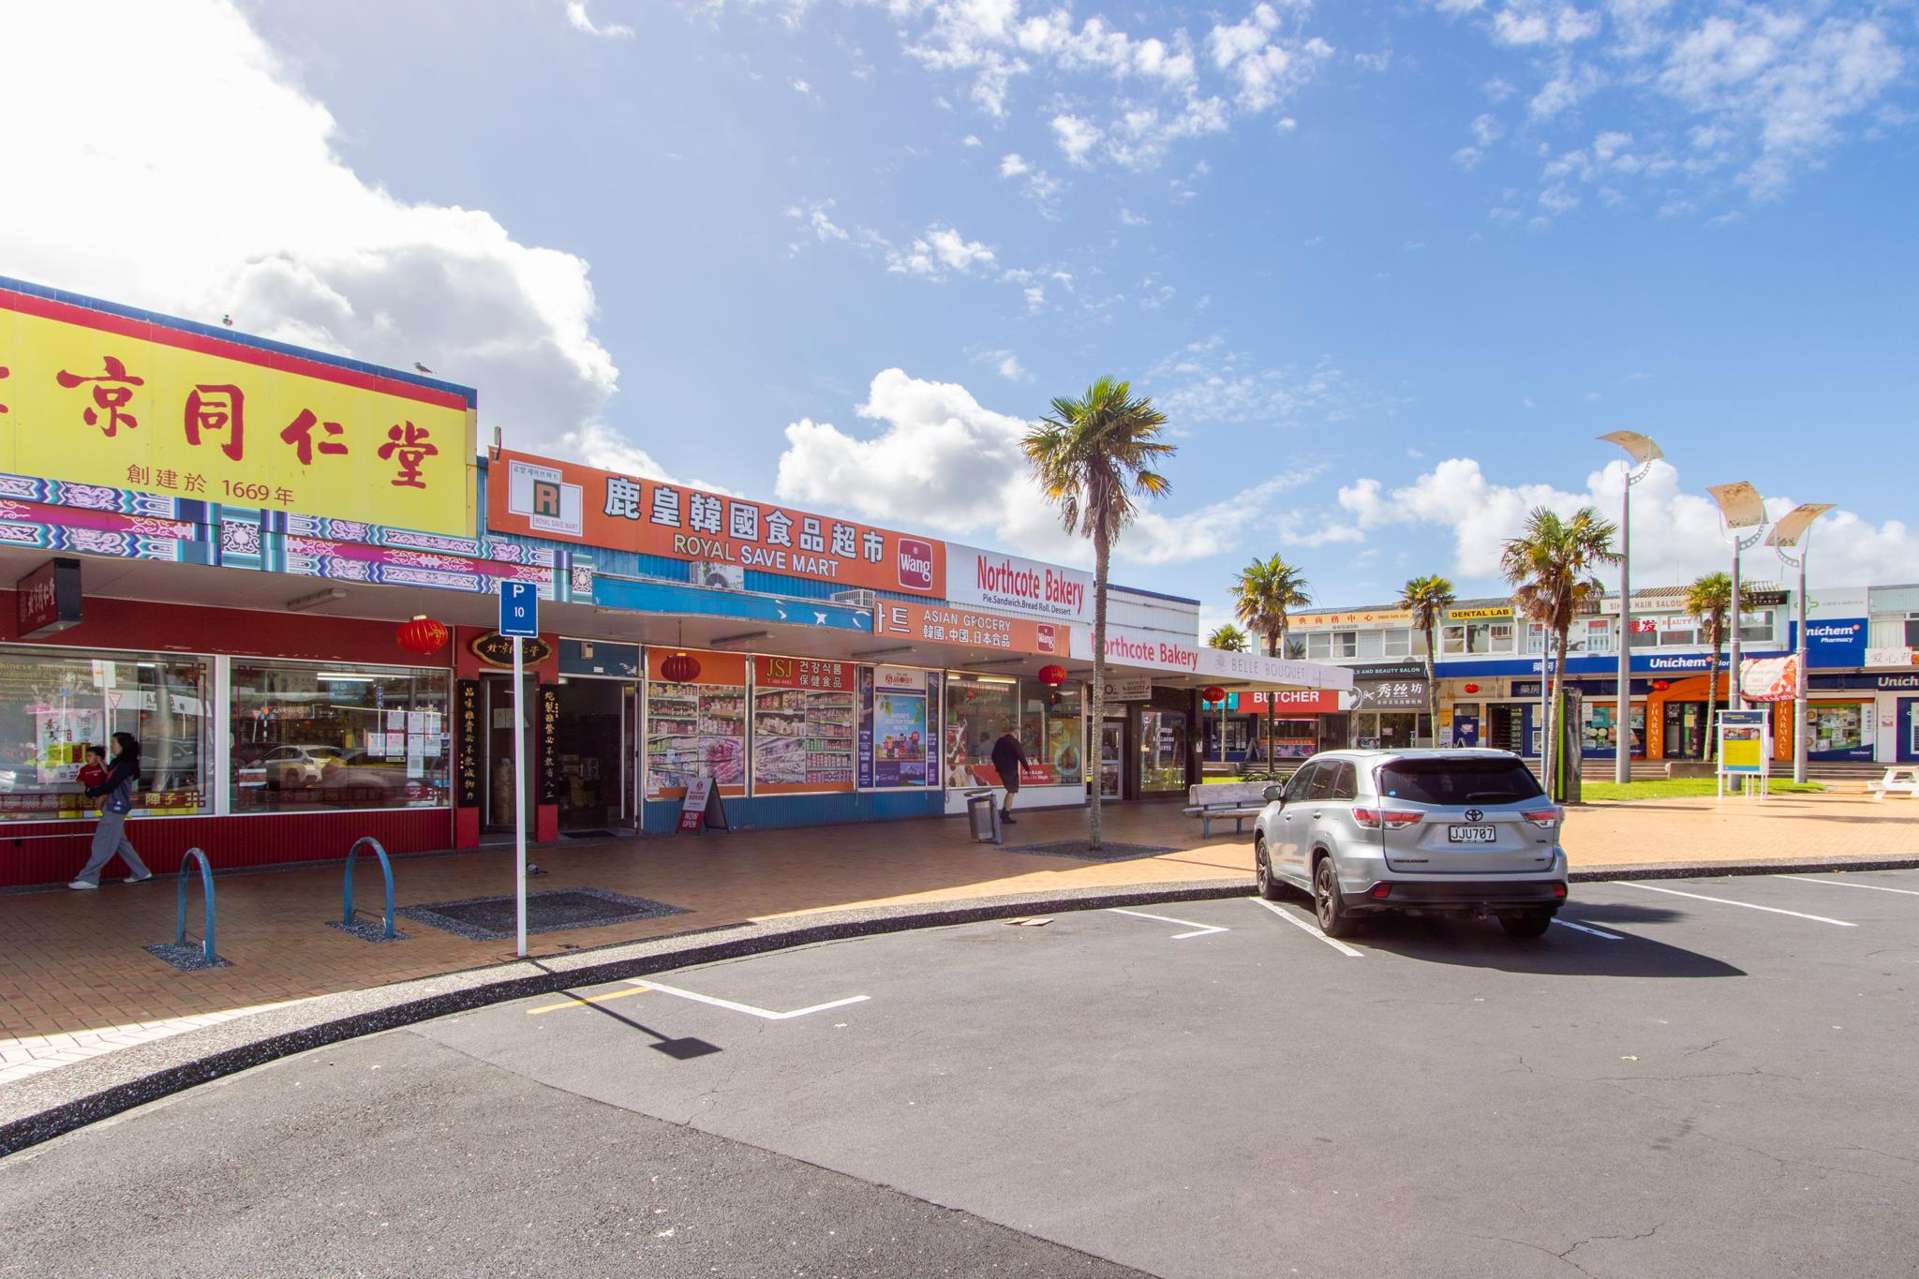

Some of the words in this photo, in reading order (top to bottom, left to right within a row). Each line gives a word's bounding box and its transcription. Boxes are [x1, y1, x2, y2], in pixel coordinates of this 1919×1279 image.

[0, 356, 439, 489] 京同仁堂
[128, 463, 207, 494] 創建於
[222, 479, 295, 506] 1669年
[535, 482, 558, 514] R
[604, 477, 884, 564] 鹿皇韓國食品超市
[674, 533, 736, 562] ROYAL
[740, 545, 787, 571] SAVE
[792, 554, 839, 577] MART
[900, 557, 931, 582] Wang
[513, 584, 525, 598] P
[977, 555, 1040, 599] Northcote
[1045, 569, 1084, 614] Bakery
[514, 607, 525, 618] 10
[923, 610, 958, 625] ASIAN
[1451, 610, 1488, 618] DENTAL
[1806, 626, 1854, 636] nichem
[767, 658, 793, 678] JSJ
[1160, 643, 1199, 671] Bakery
[1231, 659, 1259, 674] BELLE
[1649, 657, 1707, 668] Unichem
[1651, 703, 1659, 757] PHARMACY
